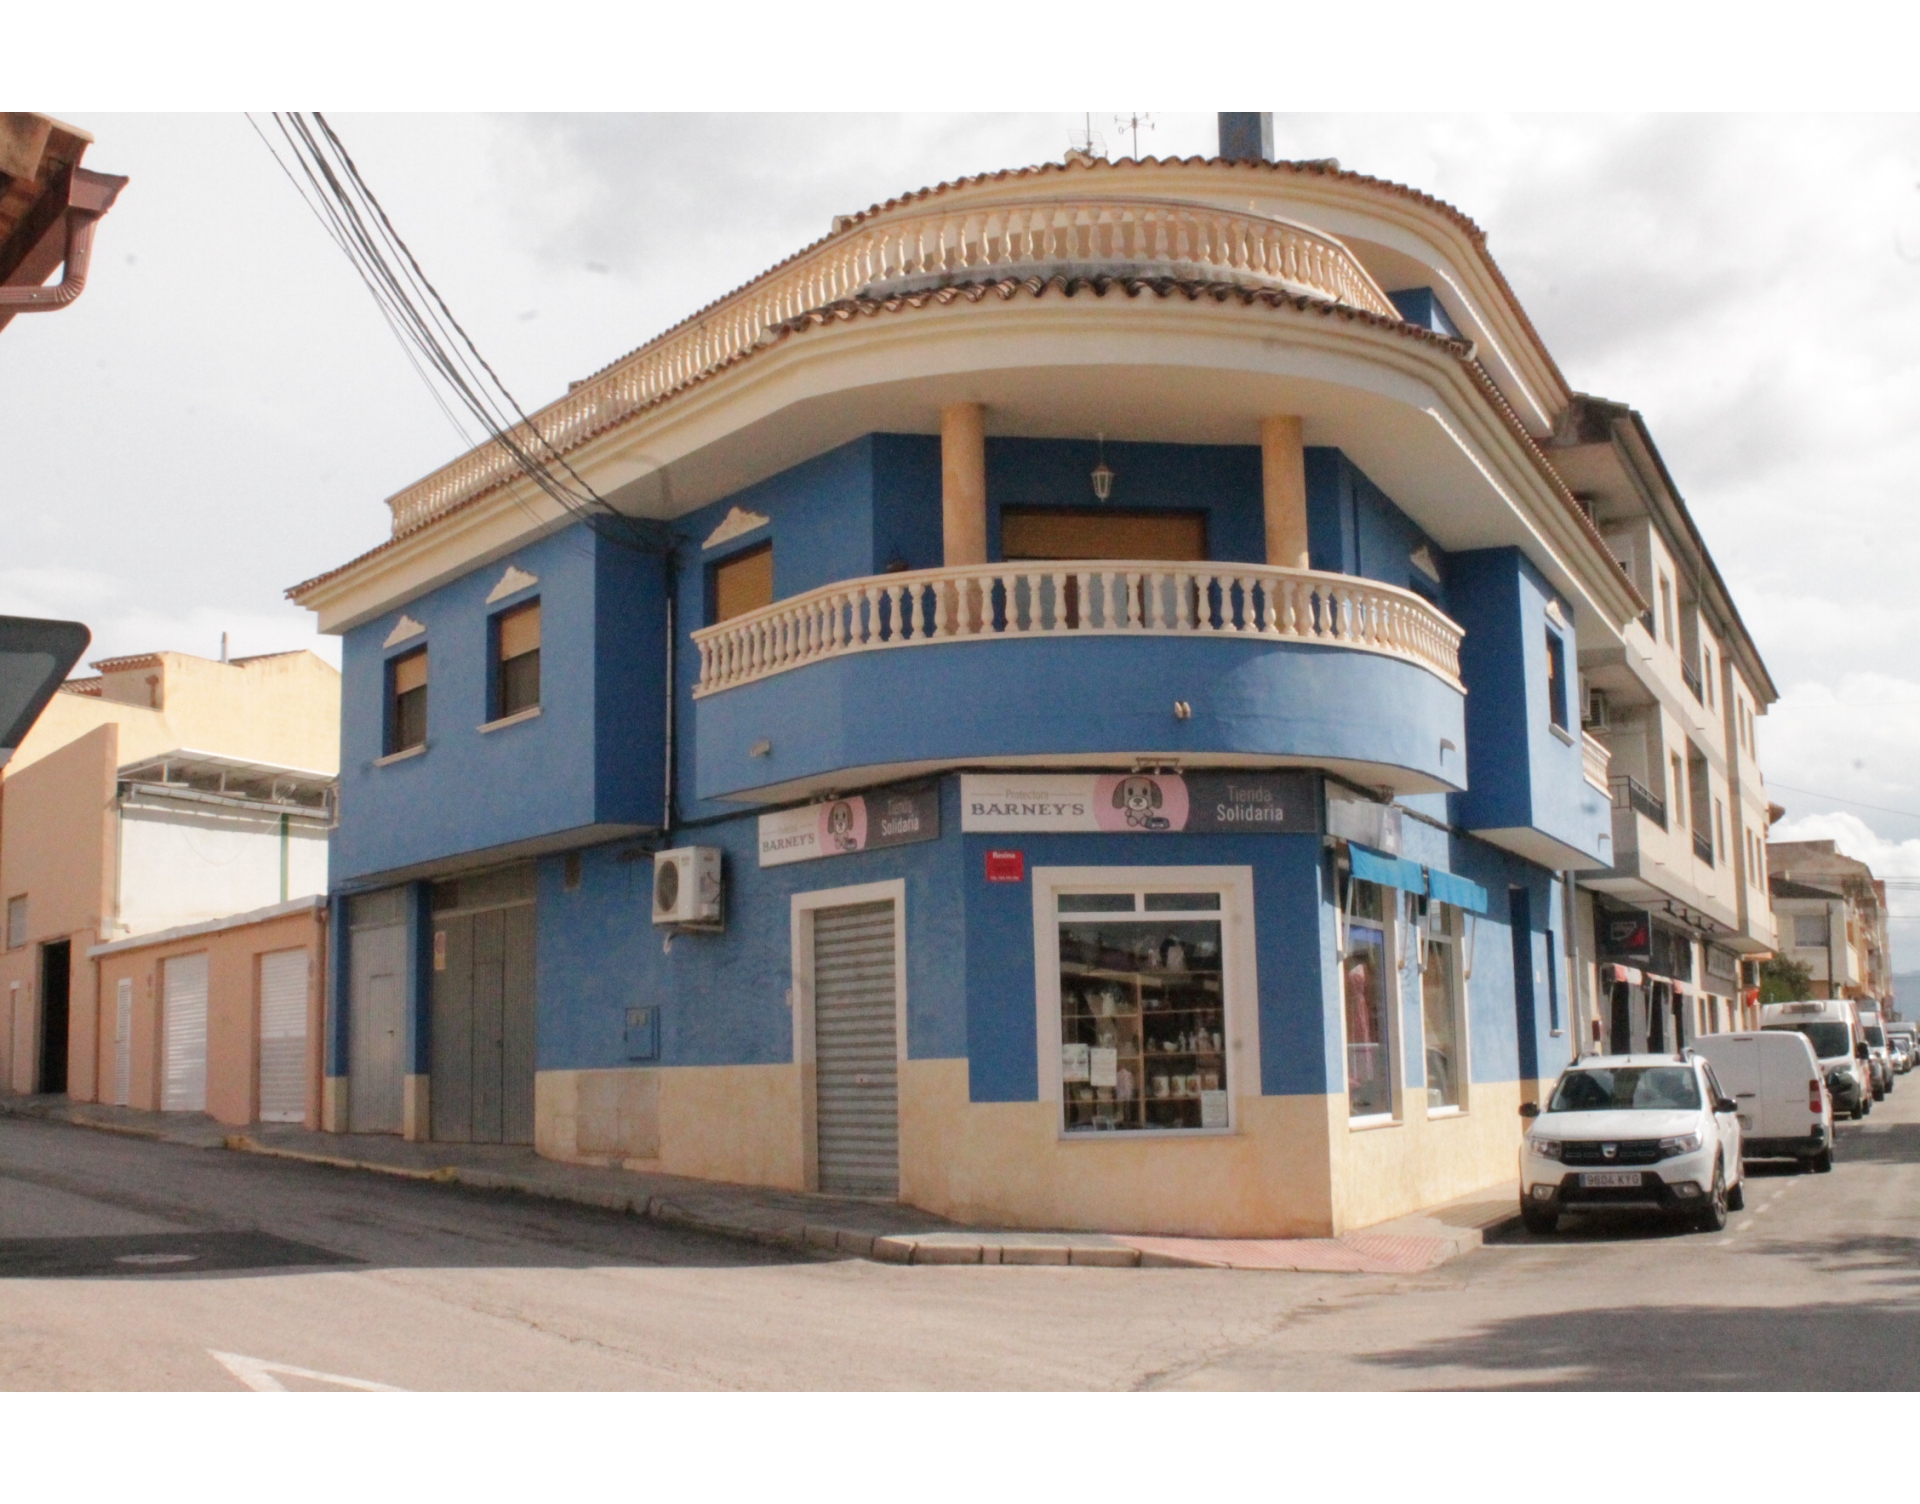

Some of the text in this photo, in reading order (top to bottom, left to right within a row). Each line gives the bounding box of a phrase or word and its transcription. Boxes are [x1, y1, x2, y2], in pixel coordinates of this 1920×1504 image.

[1226, 785, 1273, 802] Tienda
[971, 803, 1085, 816] BARNEY'S
[1217, 803, 1284, 821] Solidaria
[881, 816, 919, 836] Solidaria
